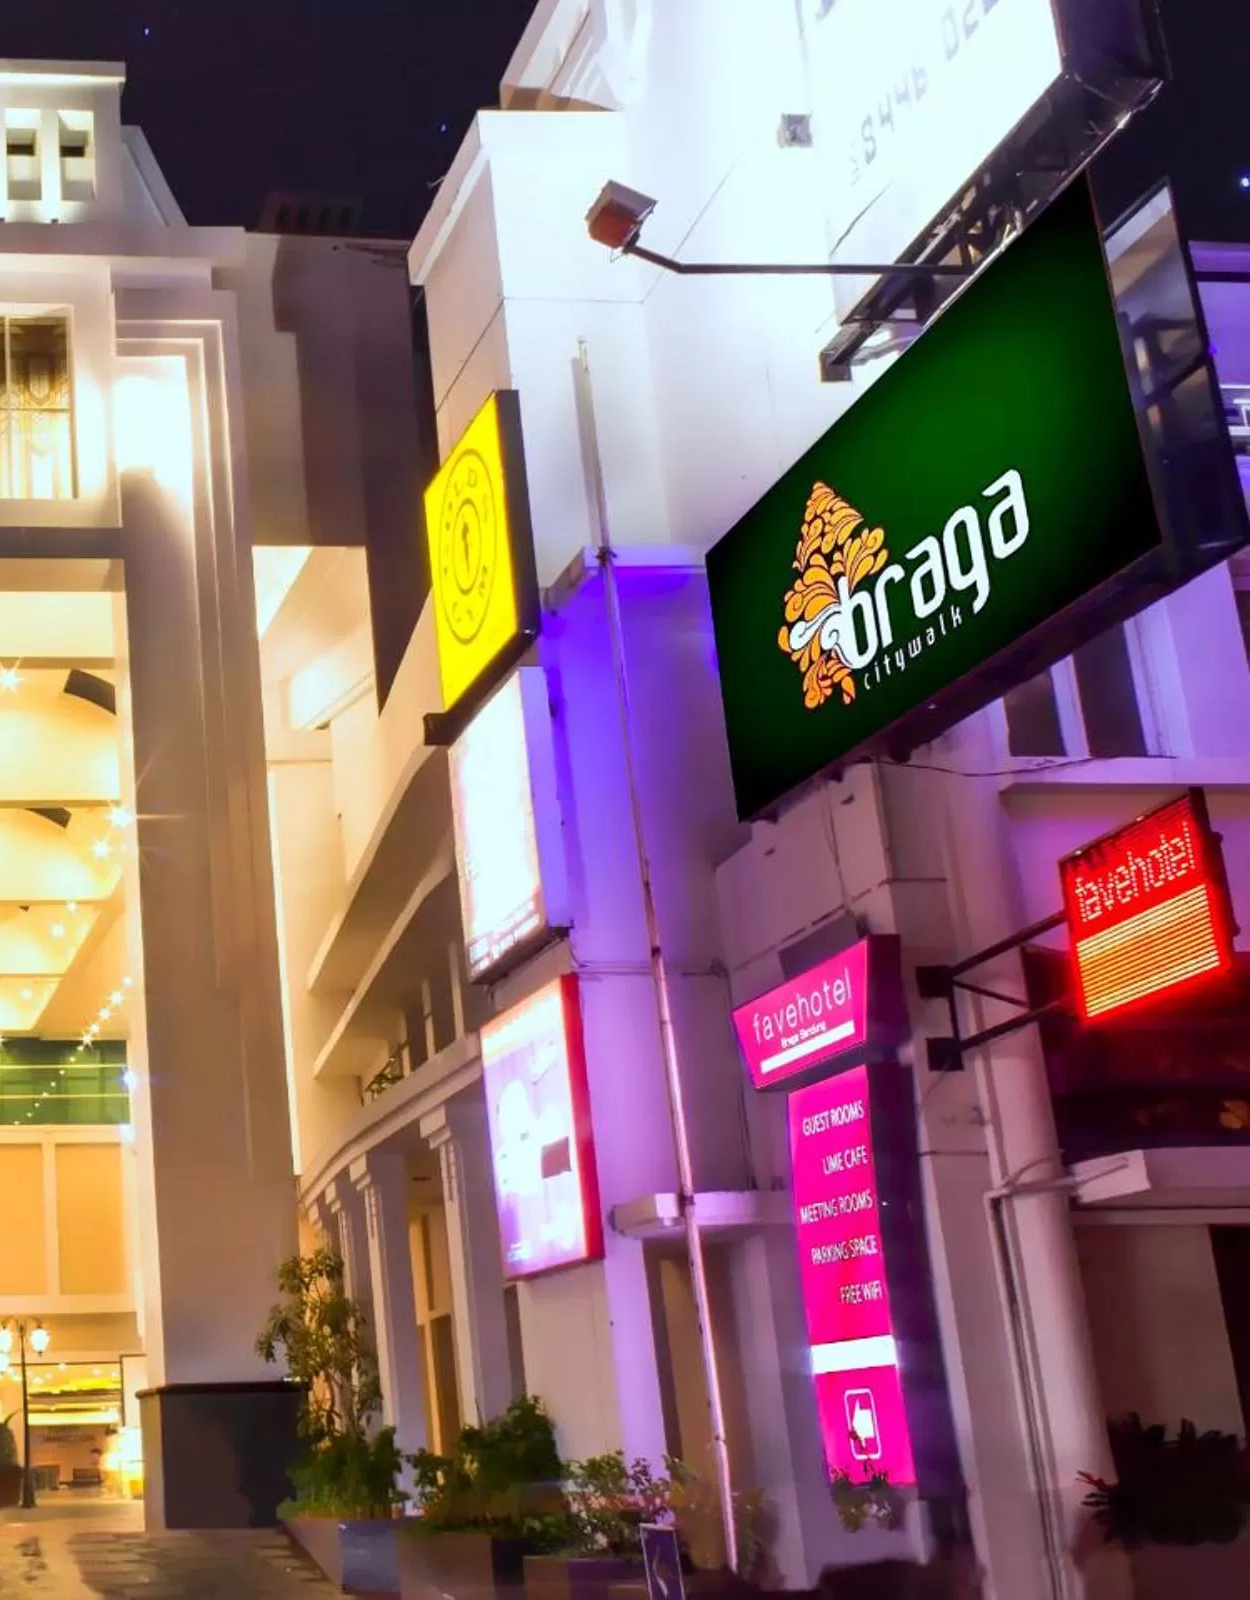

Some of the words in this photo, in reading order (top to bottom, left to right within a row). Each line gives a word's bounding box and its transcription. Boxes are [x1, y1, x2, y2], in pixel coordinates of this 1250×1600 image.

[822, 468, 1029, 669] braga
[862, 604, 964, 691] citywalk
[1074, 819, 1197, 924] favehotel
[753, 964, 852, 1045] favehotel
[803, 1111, 829, 1136] GUEST
[830, 1100, 864, 1127] ROOMS
[822, 1152, 844, 1175] LIME
[844, 1144, 868, 1169] CAFE
[800, 1198, 838, 1224] MEETING
[839, 1189, 872, 1213] ROOMS
[811, 1241, 848, 1265] PARKING
[849, 1234, 878, 1258] SPACE
[840, 1284, 862, 1304] FREE
